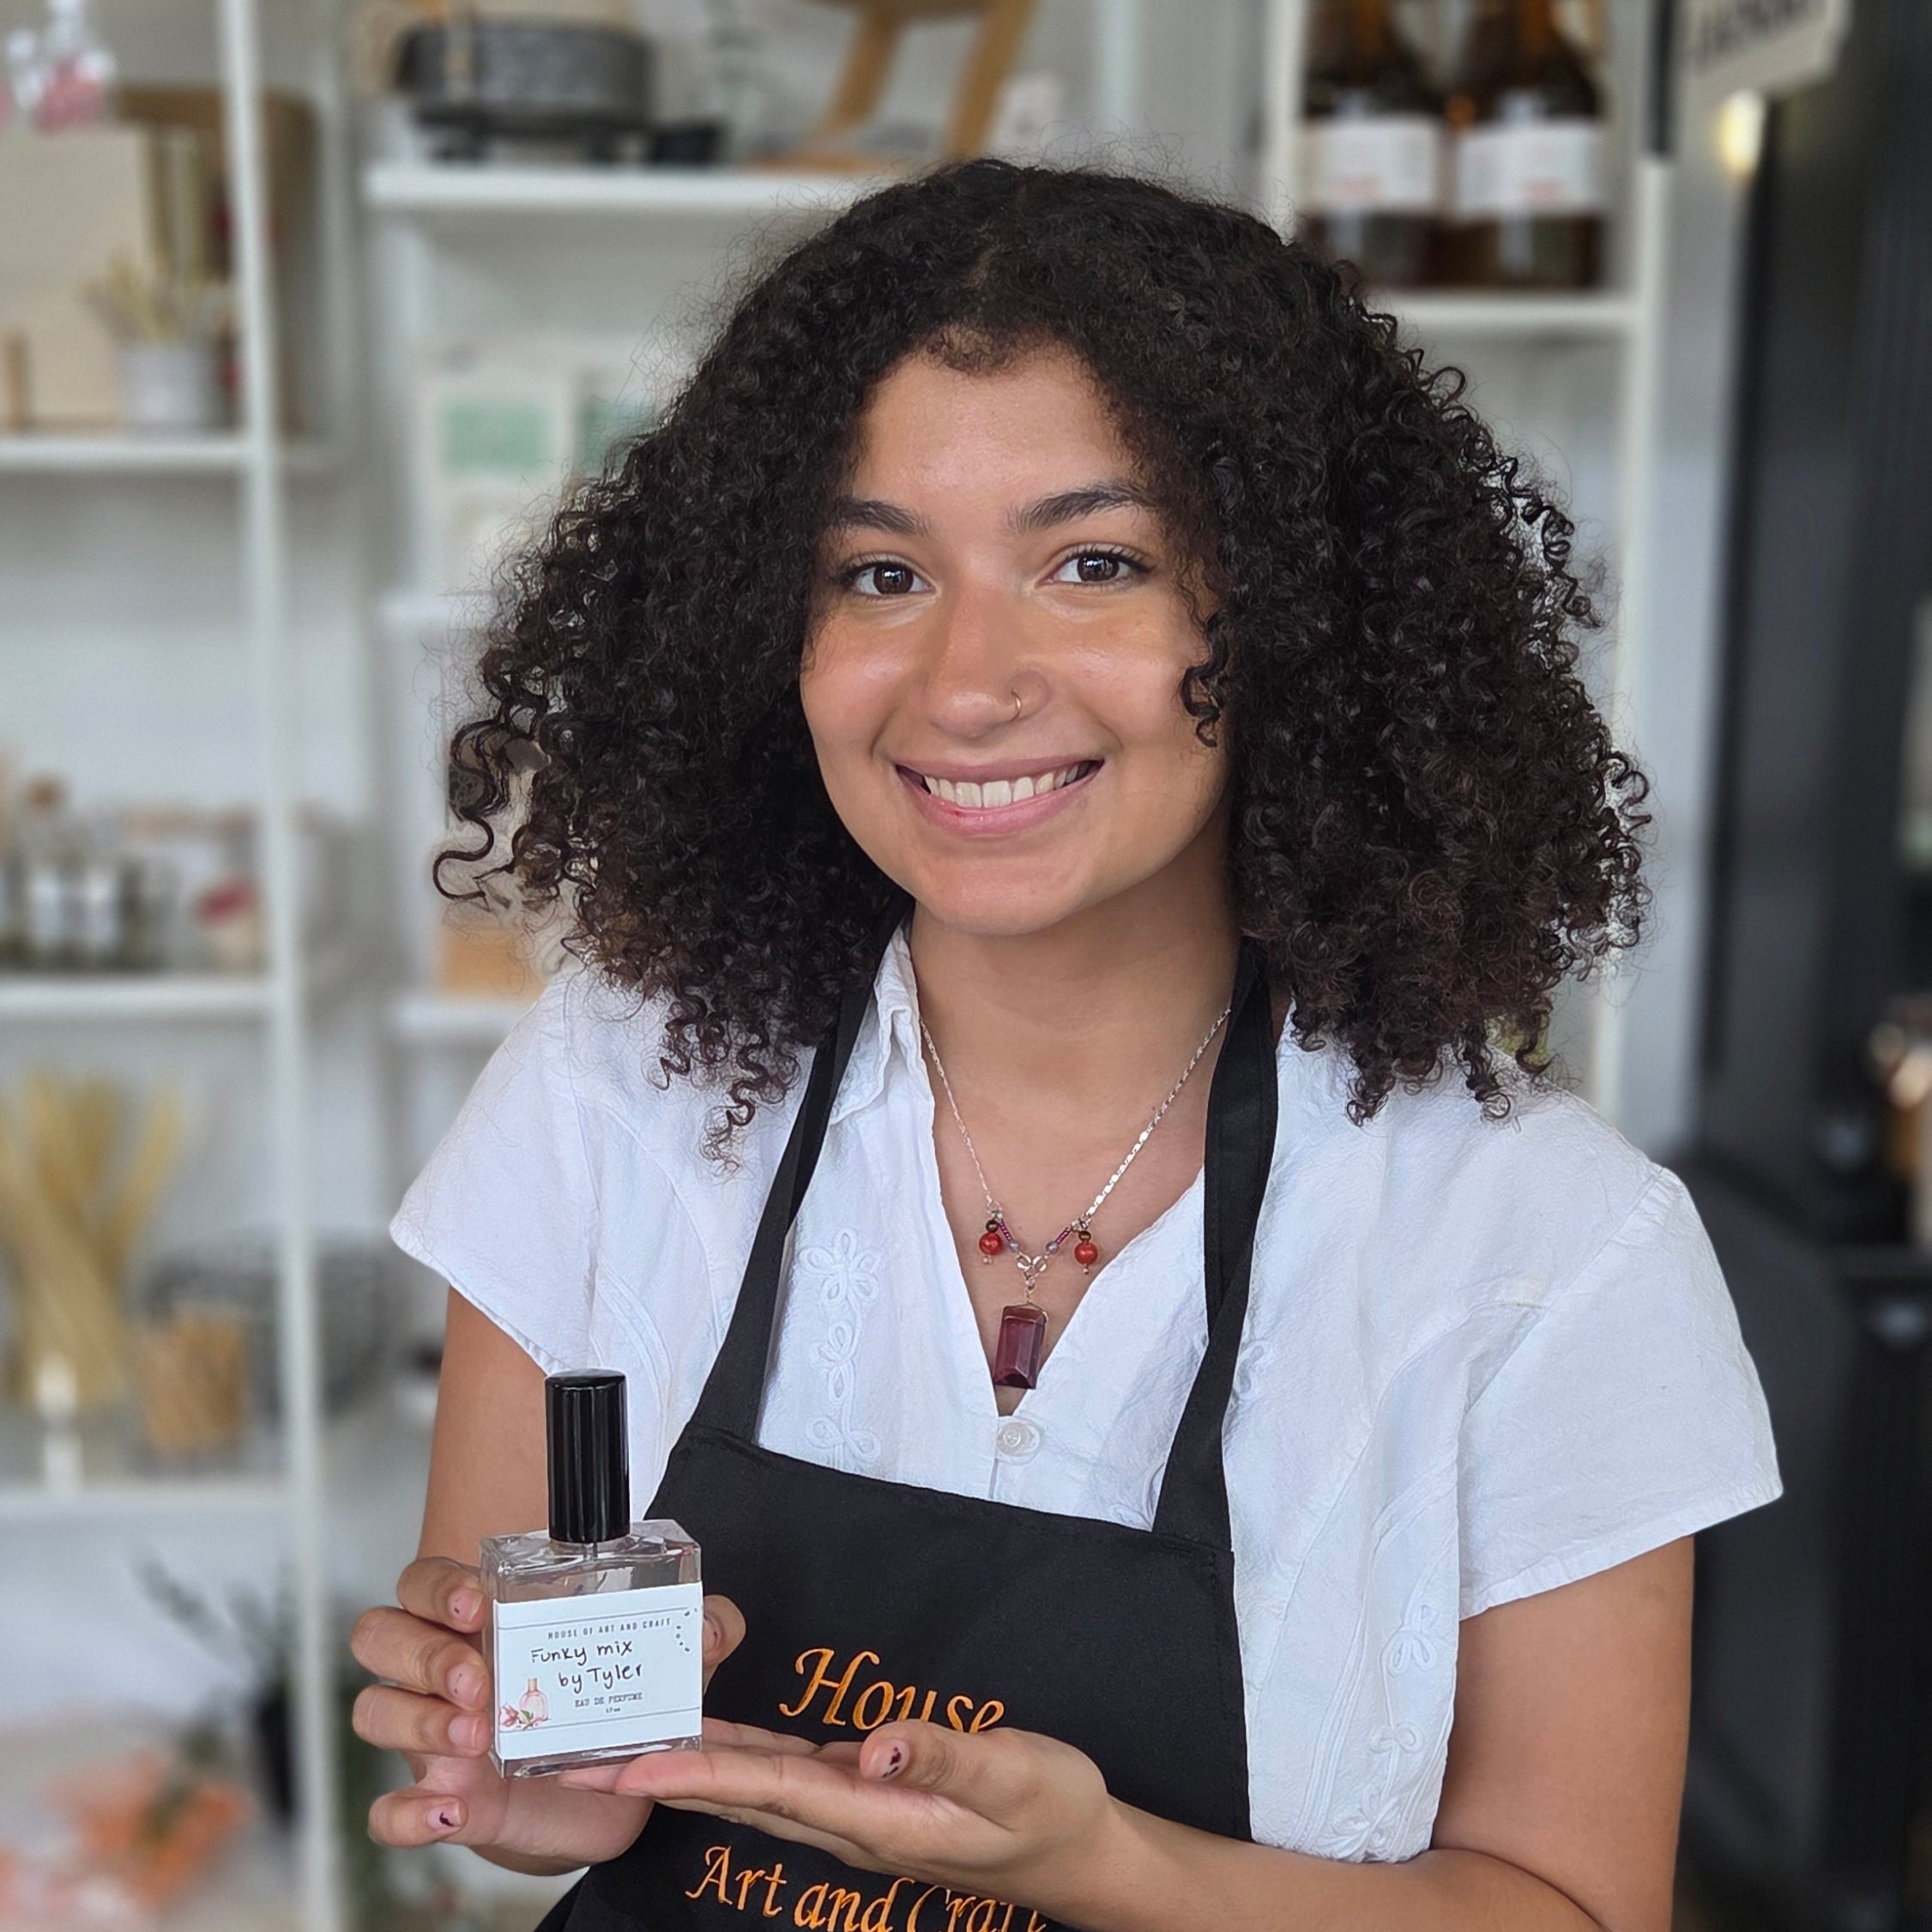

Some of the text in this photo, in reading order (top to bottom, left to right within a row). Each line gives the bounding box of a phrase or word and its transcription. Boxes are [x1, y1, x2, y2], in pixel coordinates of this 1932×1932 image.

[547, 1629, 577, 1639] HOUSE
[599, 1625, 614, 1633] ART
[620, 1622, 637, 1631] AND
[643, 1618, 670, 1628] CRAFT
[531, 1640, 632, 1666] Funky mix
[558, 1663, 643, 1694] by Tyler
[685, 1845, 787, 1917] Art
[794, 1877, 915, 1932] and
